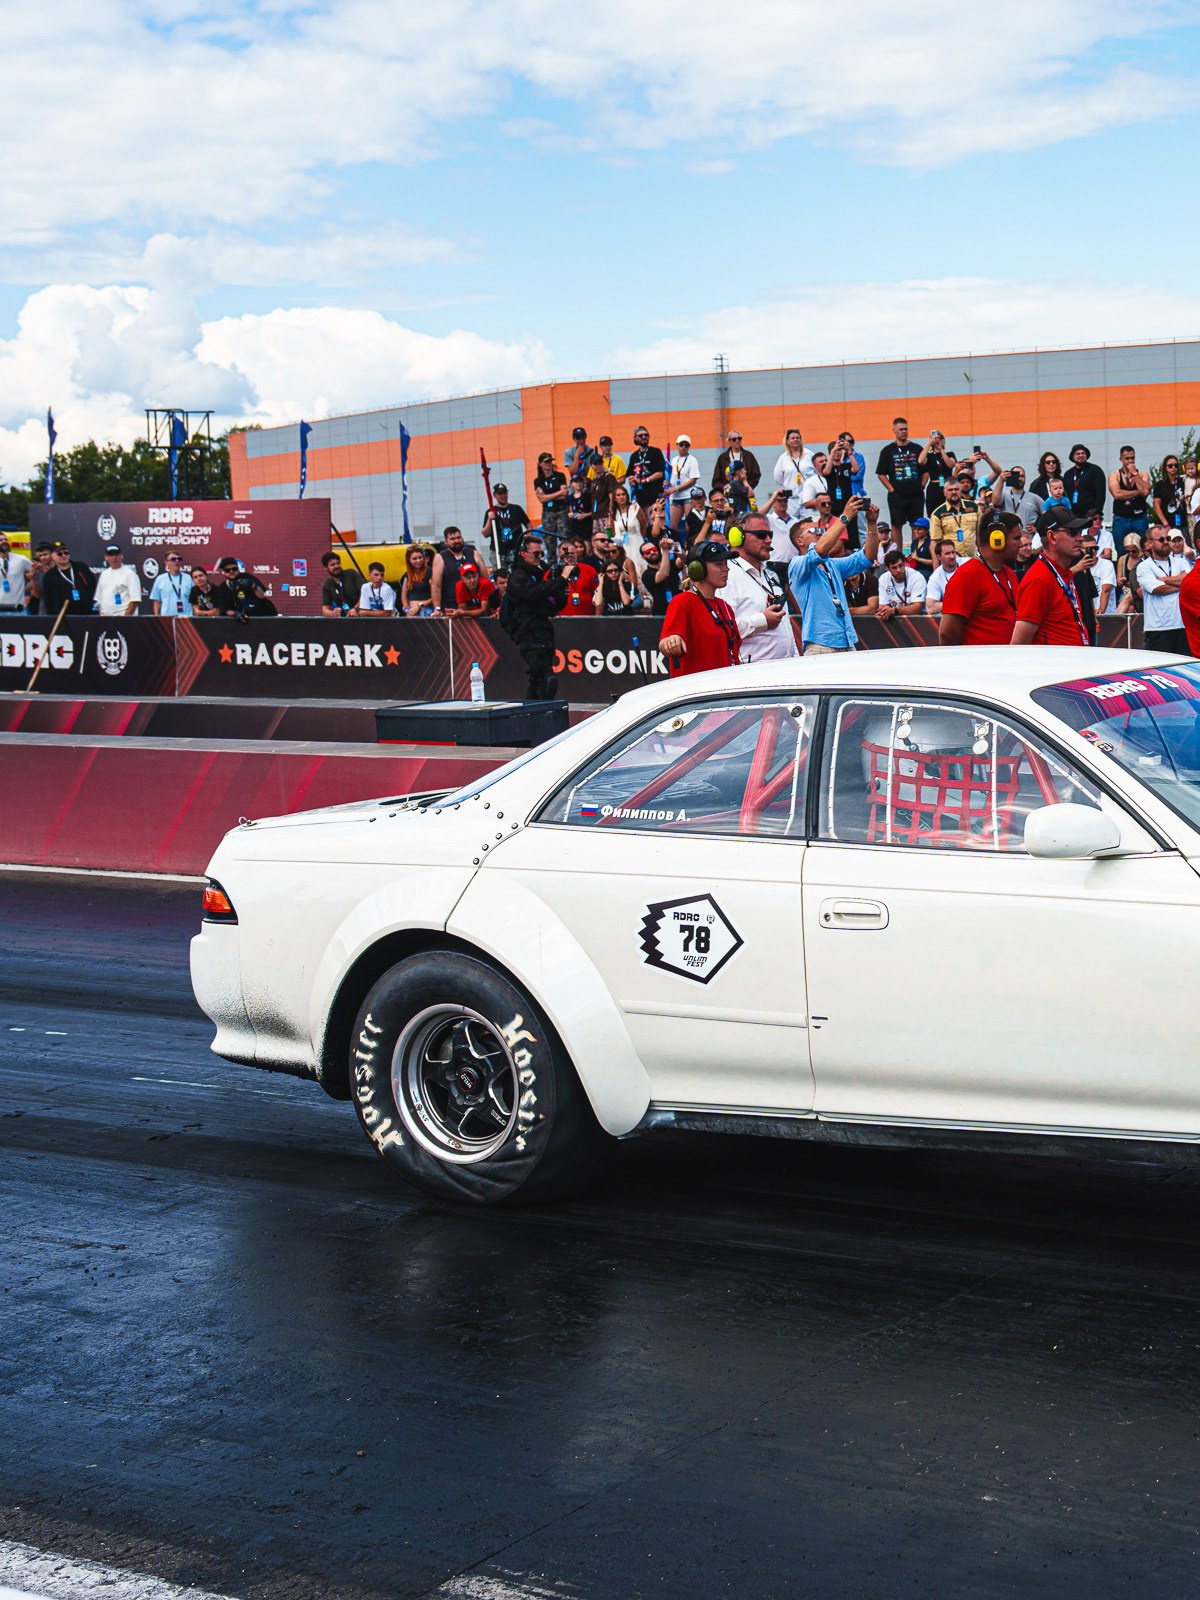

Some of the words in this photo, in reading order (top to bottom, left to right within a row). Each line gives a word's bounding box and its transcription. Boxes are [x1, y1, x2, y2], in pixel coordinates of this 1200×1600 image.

[148, 507, 194, 523] RDRC
[129, 526, 177, 536] ЧЕМПИОНАТ
[178, 526, 212, 536] РОССИИ
[233, 523, 251, 534] ВТБ
[131, 536, 144, 545] ПО
[289, 586, 307, 597] ВТБ
[0, 633, 74, 669] DRC
[235, 642, 383, 668] RACEPARK
[1083, 679, 1148, 700] RDRC
[1140, 674, 1180, 690] 78
[600, 804, 674, 821] Филиппов
[675, 808, 691, 821] А.
[673, 911, 700, 922] RDRC
[679, 924, 711, 954] 78
[352, 1012, 405, 1156] Hoosier
